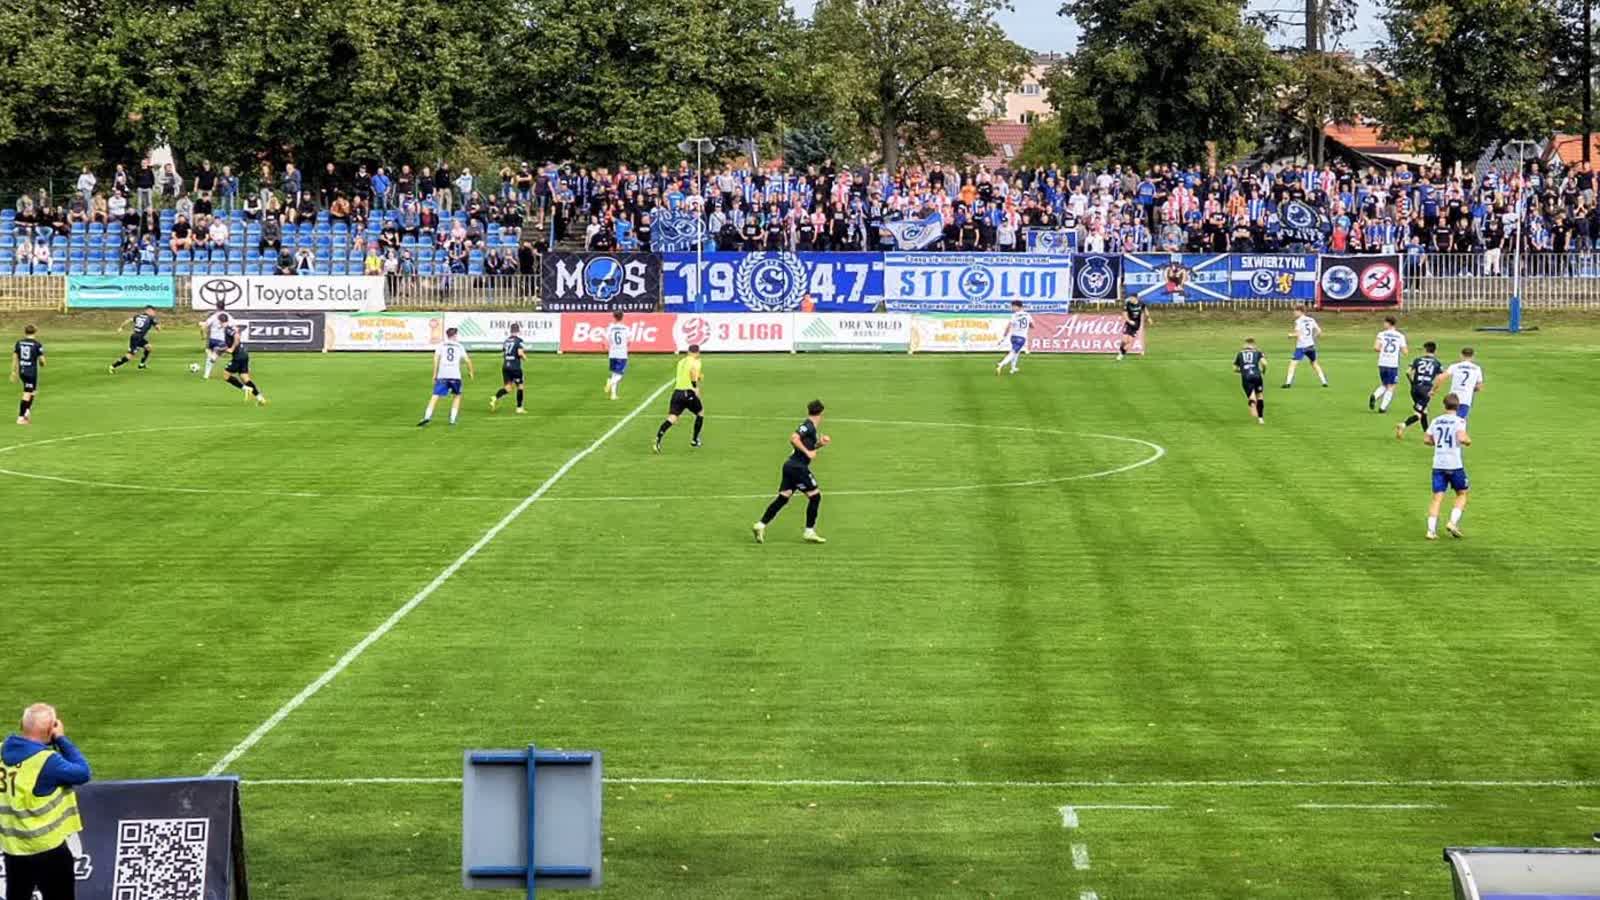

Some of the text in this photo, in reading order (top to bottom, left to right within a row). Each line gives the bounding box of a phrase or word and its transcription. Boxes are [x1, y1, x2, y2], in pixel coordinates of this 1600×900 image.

[1241, 256, 1306, 269] SKWIERZYNA
[255, 284, 313, 304] Toyota
[1018, 317, 1027, 329] 19
[1305, 323, 1311, 336] 5
[614, 331, 622, 345] 6
[719, 323, 783, 340] 3 LIGA
[1032, 338, 1143, 350] RESTAURACA
[1384, 338, 1396, 353] 25
[20, 345, 31, 360] 19
[447, 348, 455, 362] 8
[1242, 351, 1254, 363] 10
[1418, 360, 1434, 375] 24
[1437, 427, 1452, 448] 24
